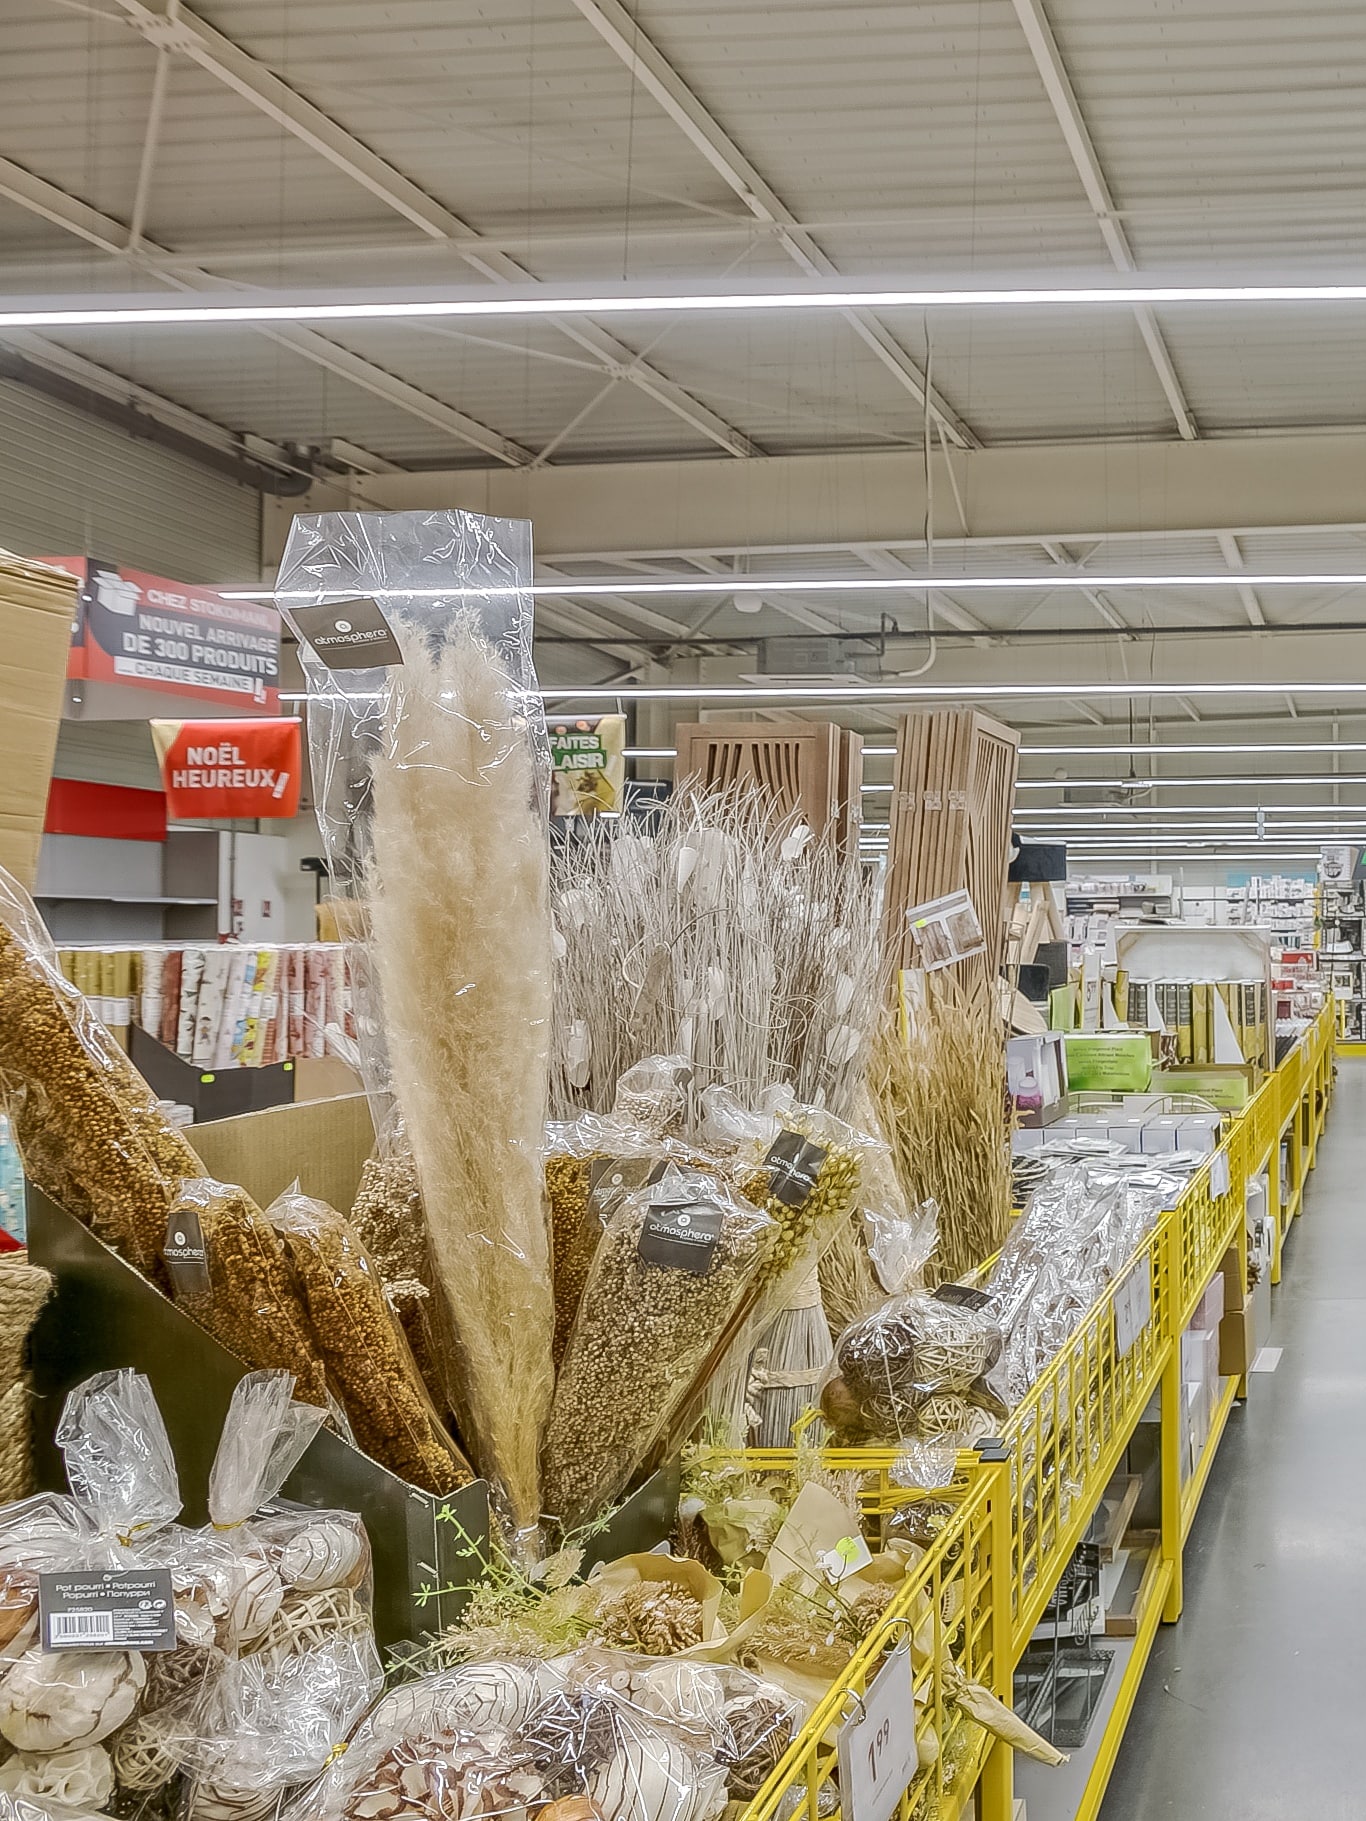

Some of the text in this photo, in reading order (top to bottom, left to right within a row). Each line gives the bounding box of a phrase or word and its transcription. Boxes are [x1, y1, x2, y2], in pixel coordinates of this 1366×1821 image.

[147, 588, 188, 610] CHEZ
[138, 613, 278, 655] NOUVEL ARRIVAGE
[314, 628, 387, 645] atmosphera
[122, 632, 278, 676] DE 300 PRODUITS
[187, 742, 246, 766] NOËL
[551, 752, 604, 770] LAISIR
[649, 1223, 712, 1241] atmosphera
[867, 1718, 890, 1783] 199
